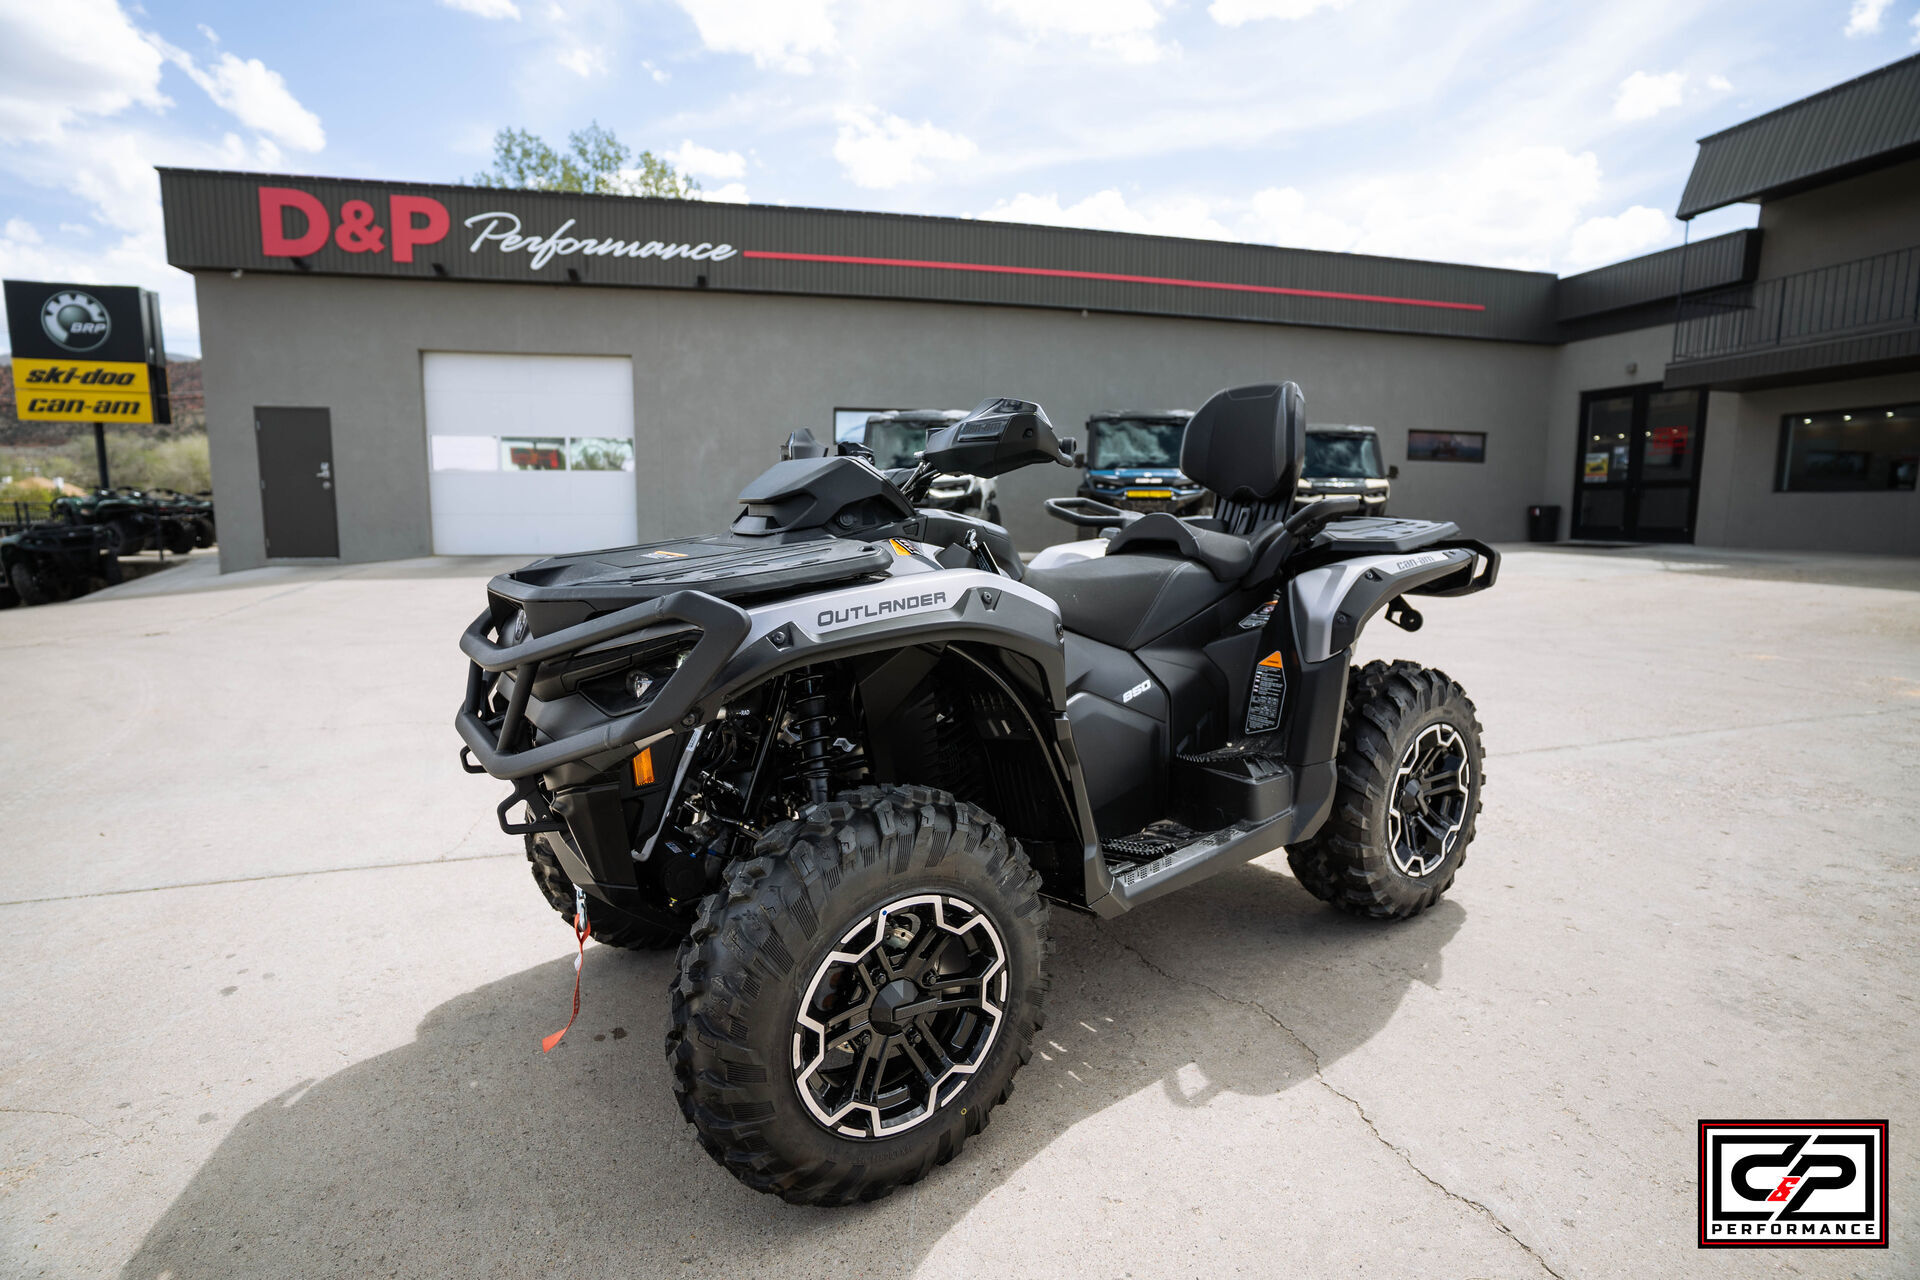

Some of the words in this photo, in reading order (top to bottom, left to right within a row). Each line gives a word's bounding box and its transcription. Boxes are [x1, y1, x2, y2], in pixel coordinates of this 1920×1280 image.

[258, 186, 450, 263] D&P
[464, 211, 737, 270] Performance
[70, 322, 106, 334] BRP
[25, 367, 136, 386] ski-doo
[27, 397, 141, 415] can-am
[817, 591, 947, 627] OUTLANDER
[1122, 679, 1152, 703] 850
